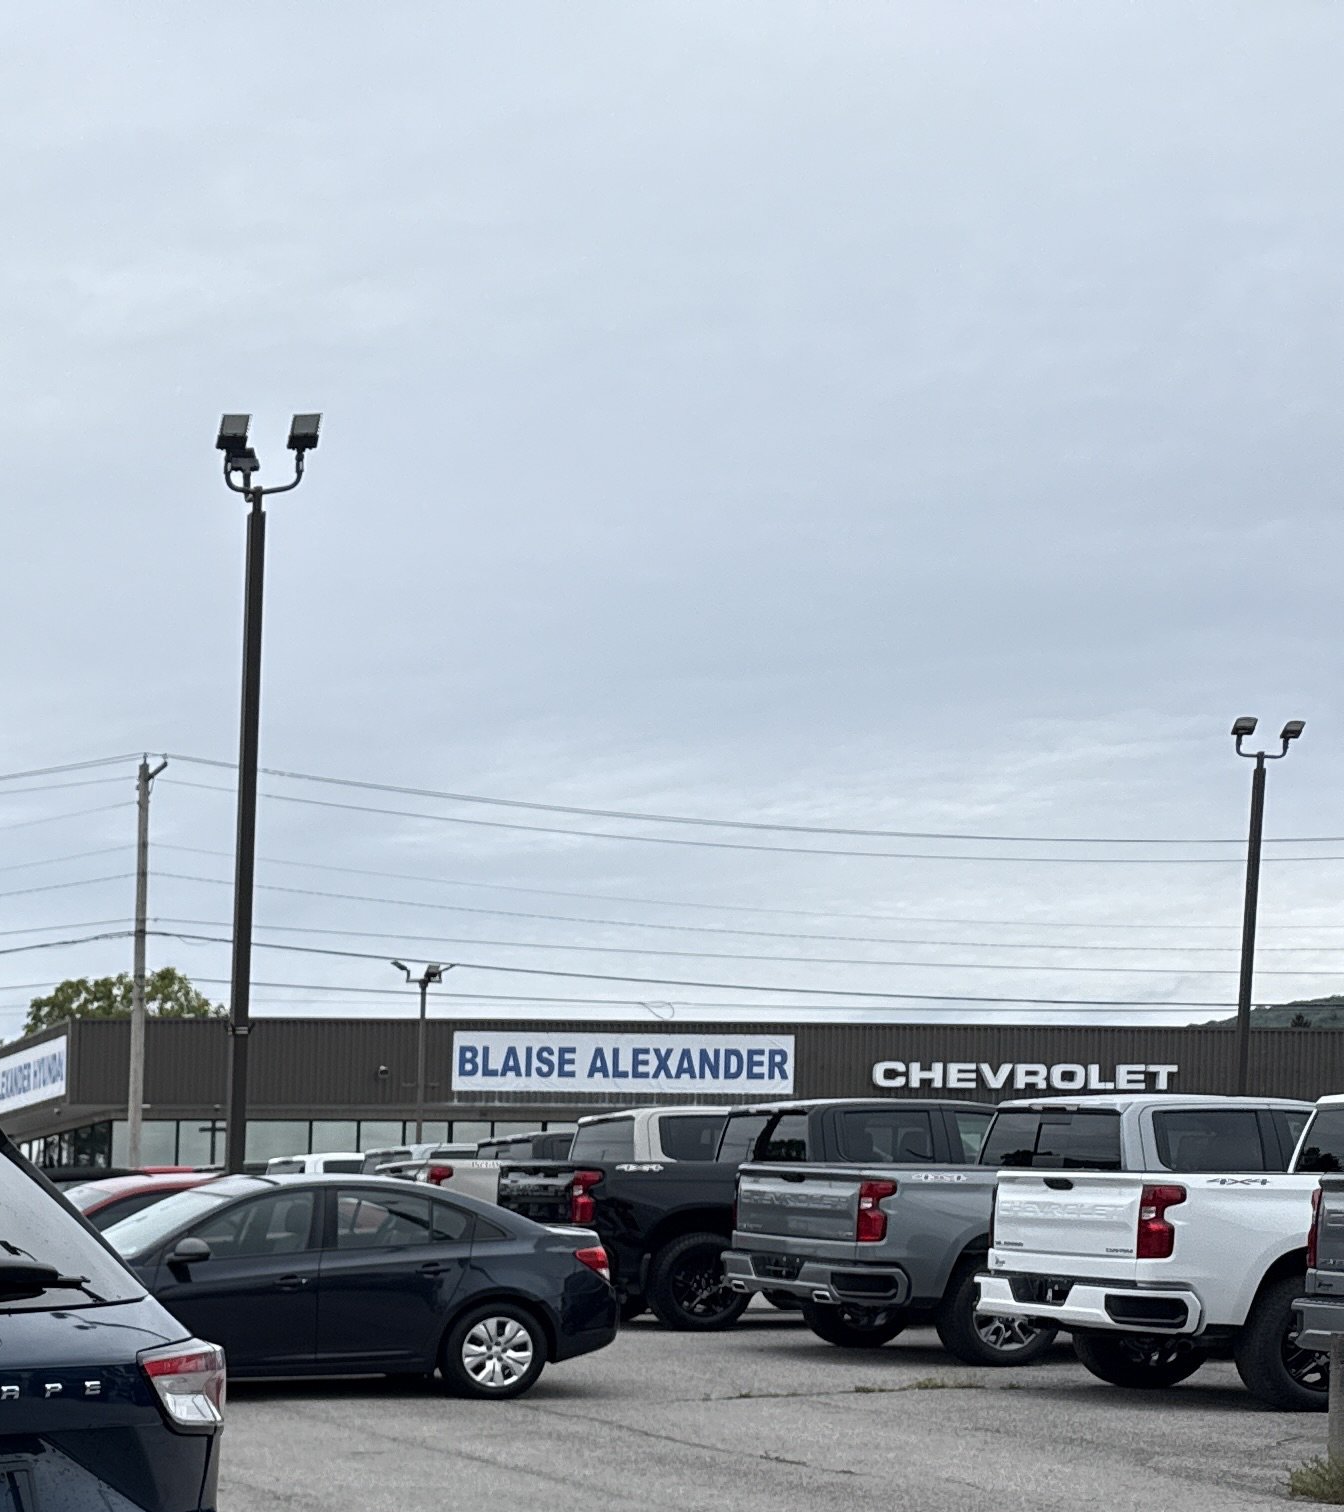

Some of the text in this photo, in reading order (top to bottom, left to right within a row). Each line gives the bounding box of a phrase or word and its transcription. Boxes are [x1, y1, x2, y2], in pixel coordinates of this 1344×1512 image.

[458, 1045, 788, 1080] BLAISE ALEXANDER
[872, 1061, 1179, 1090] CHEVROLET
